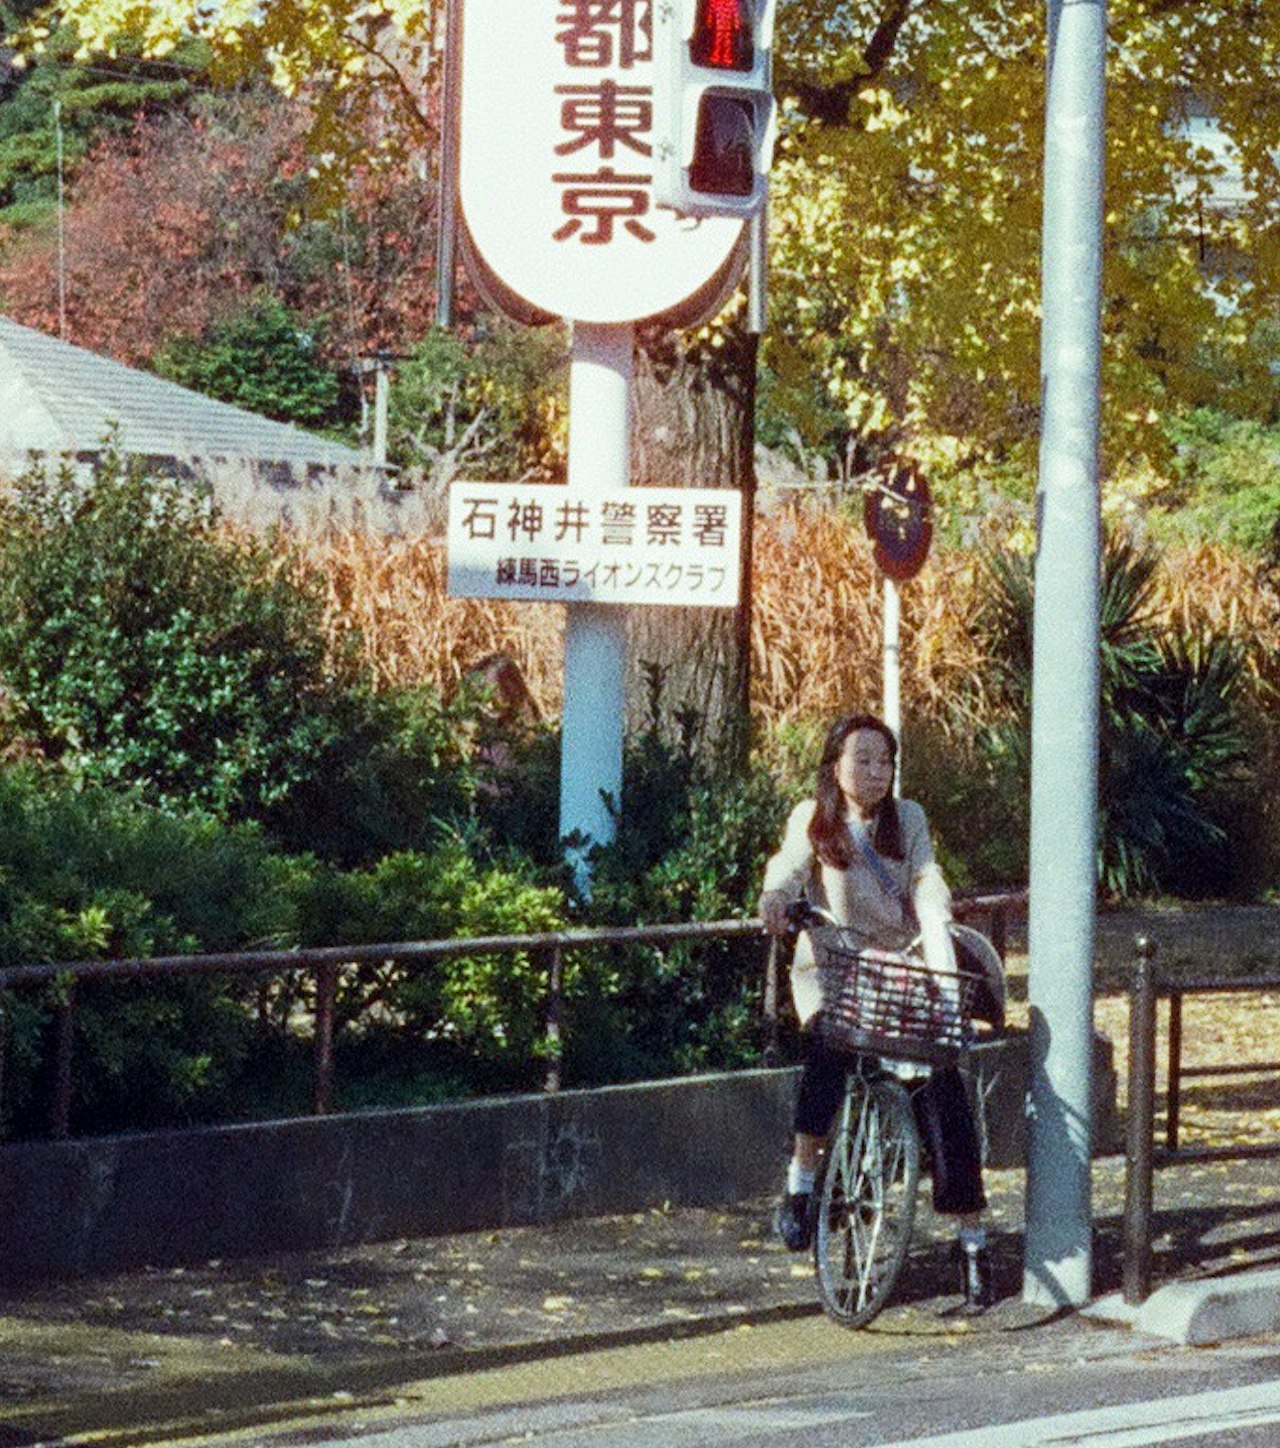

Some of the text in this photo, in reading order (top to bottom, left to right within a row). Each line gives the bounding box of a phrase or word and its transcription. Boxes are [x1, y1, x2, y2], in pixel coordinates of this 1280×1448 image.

[461, 497, 728, 547] 石神井警察署
